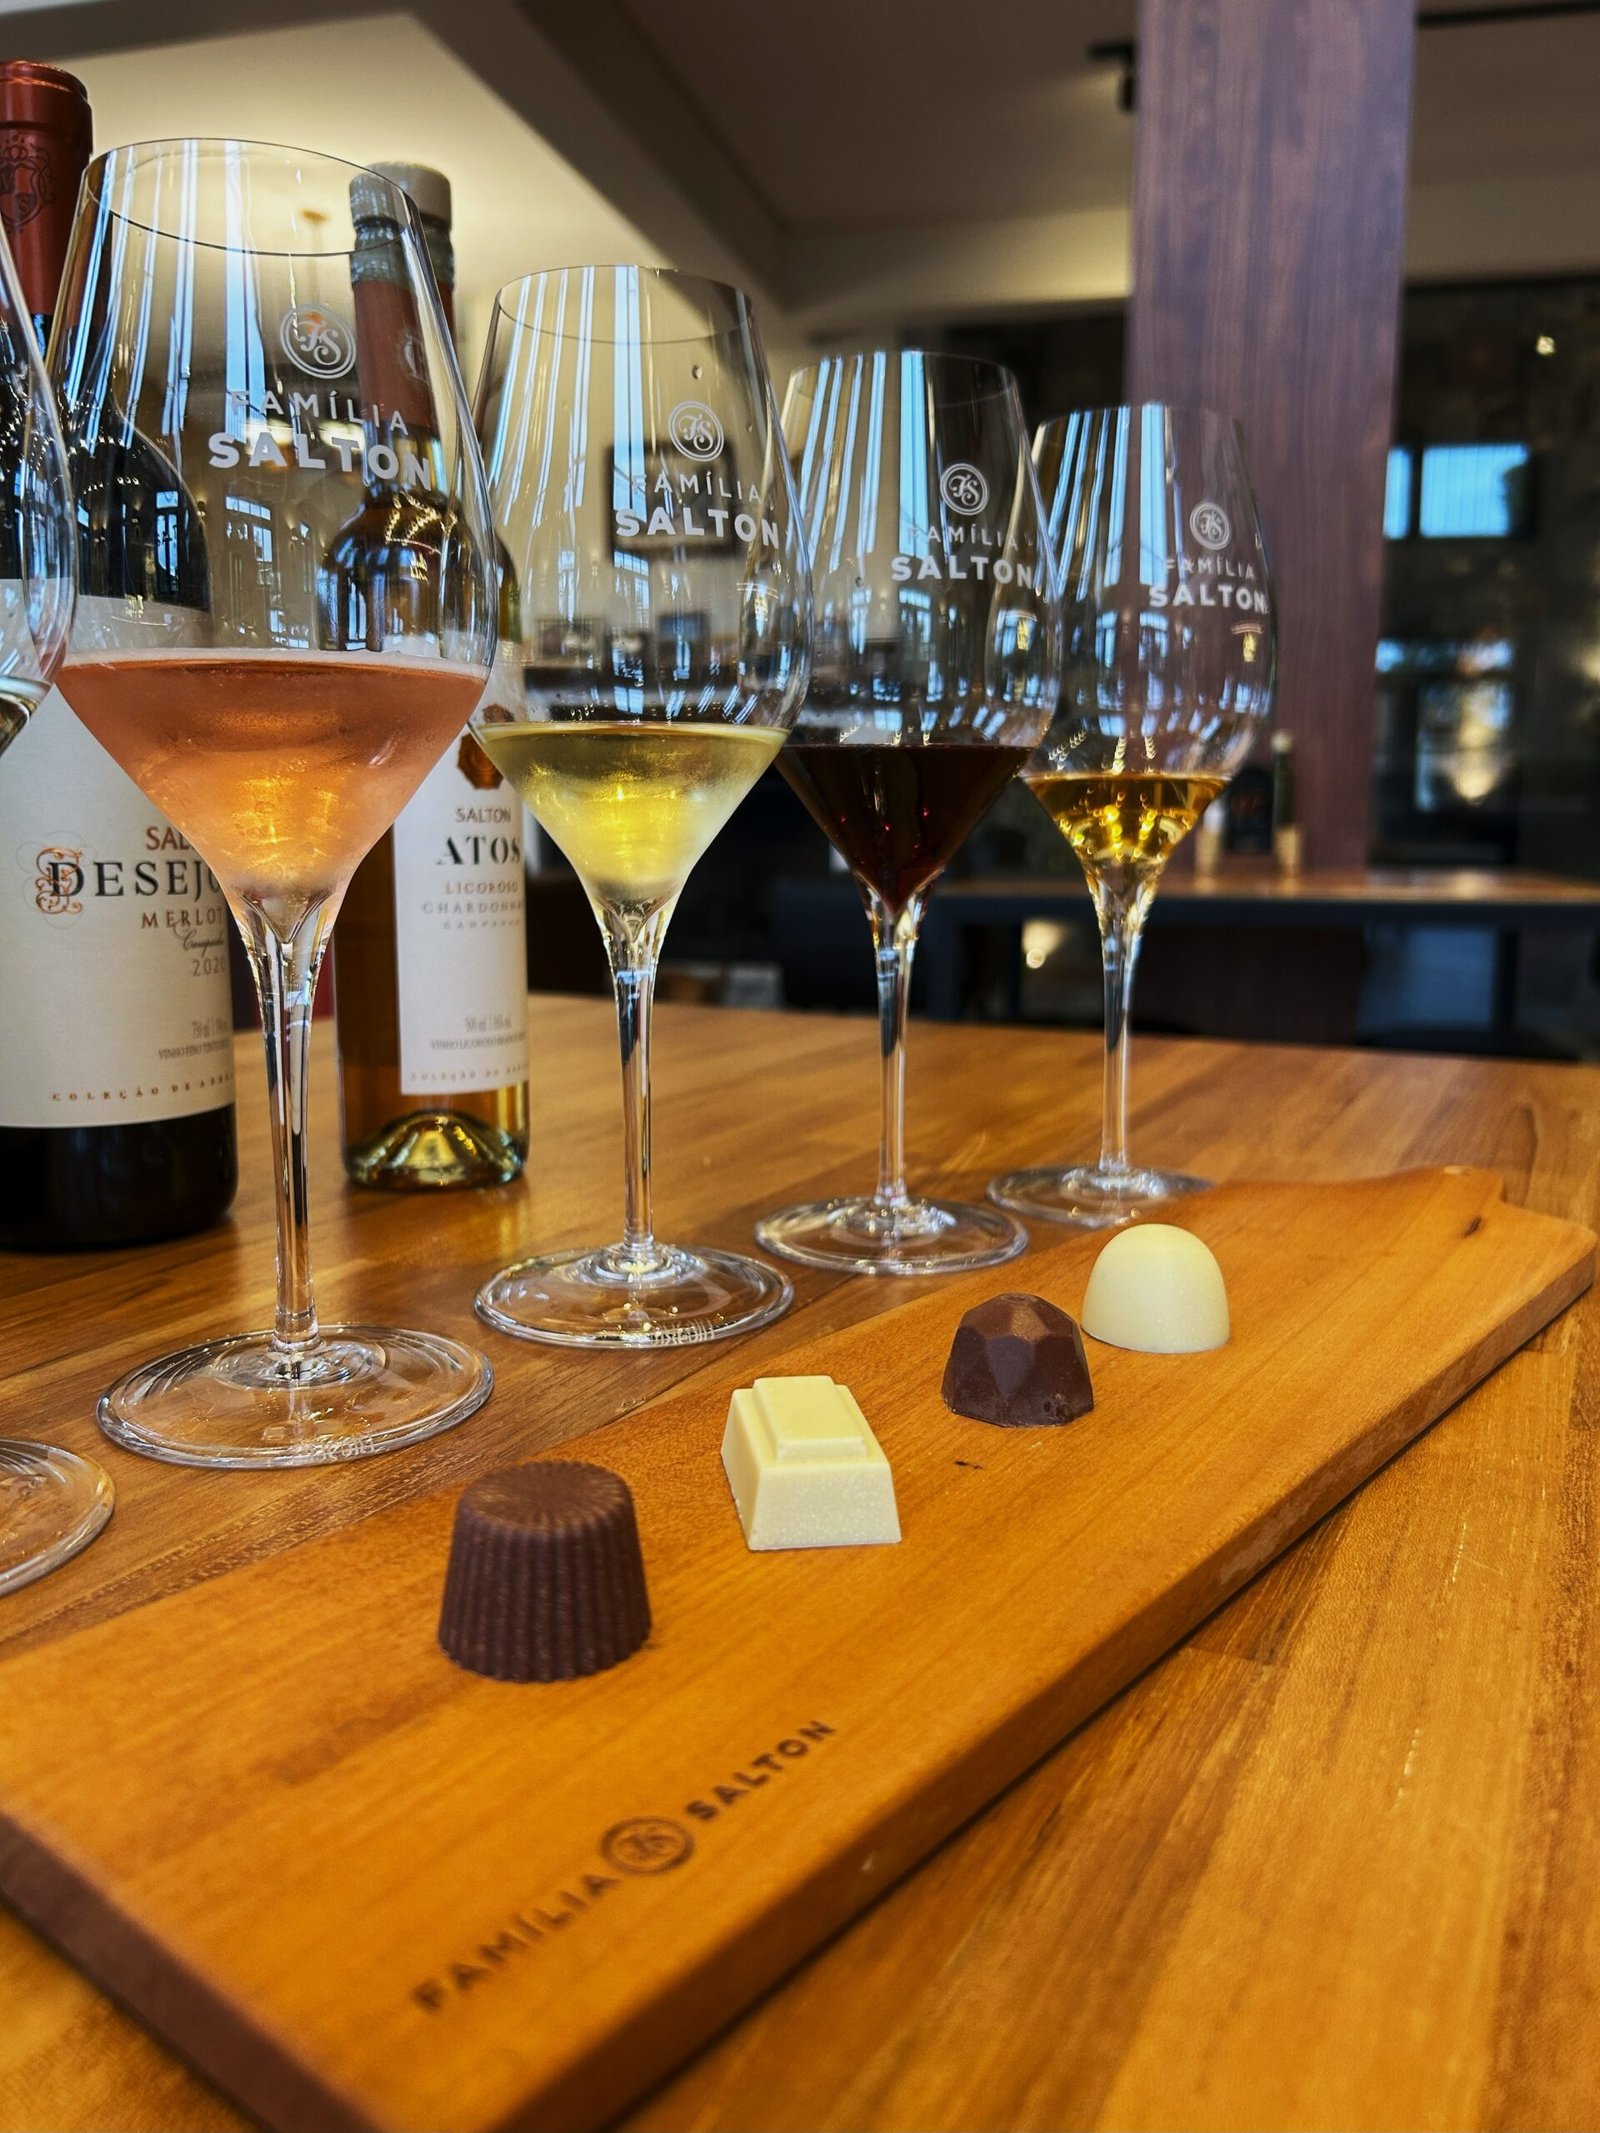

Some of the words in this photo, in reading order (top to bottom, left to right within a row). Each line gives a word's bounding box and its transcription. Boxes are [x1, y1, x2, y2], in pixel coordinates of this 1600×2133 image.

[231, 389, 409, 436] FAMÍLIA
[208, 432, 432, 491] SALTON
[632, 470, 762, 504] FAMÍLIA
[615, 507, 779, 549] SALTON
[891, 555, 1033, 590] SALTON
[1149, 583, 1267, 615] SALTON
[456, 807, 512, 824] SALTON
[146, 826, 194, 851] SAL
[436, 836, 521, 866] ATOS
[53, 1086, 159, 1101] COLEÇÃO
[685, 1720, 837, 1822] SALTON
